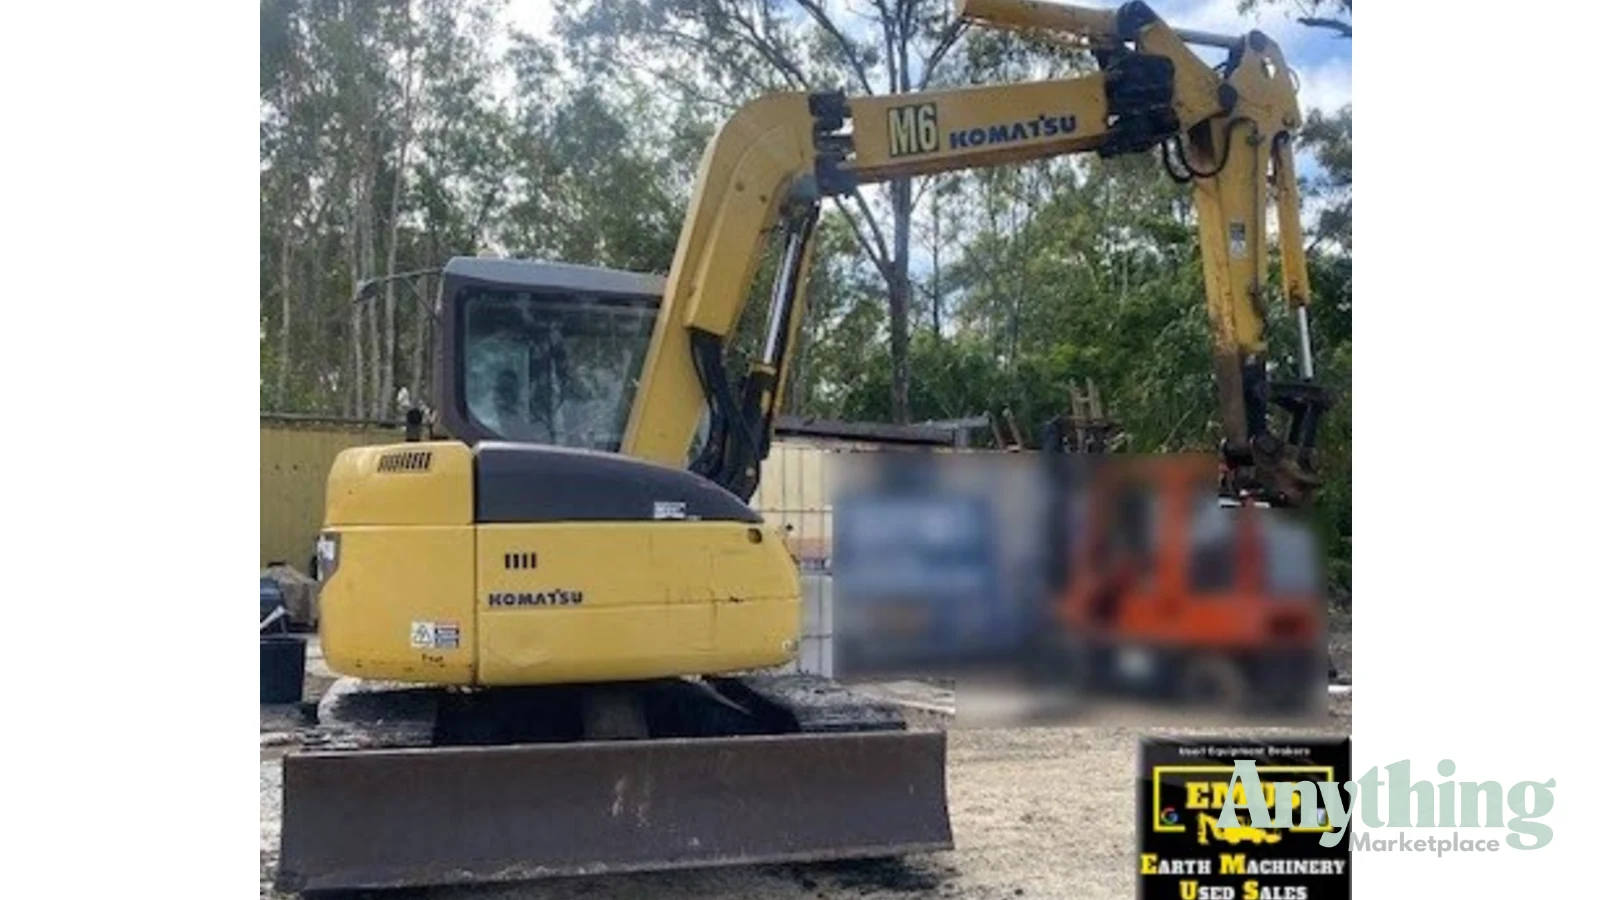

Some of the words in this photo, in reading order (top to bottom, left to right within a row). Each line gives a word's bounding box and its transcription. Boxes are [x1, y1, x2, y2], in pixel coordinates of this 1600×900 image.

[888, 104, 939, 156] M6
[949, 113, 1077, 148] KOMATSU
[488, 588, 583, 606] KOMATSU
